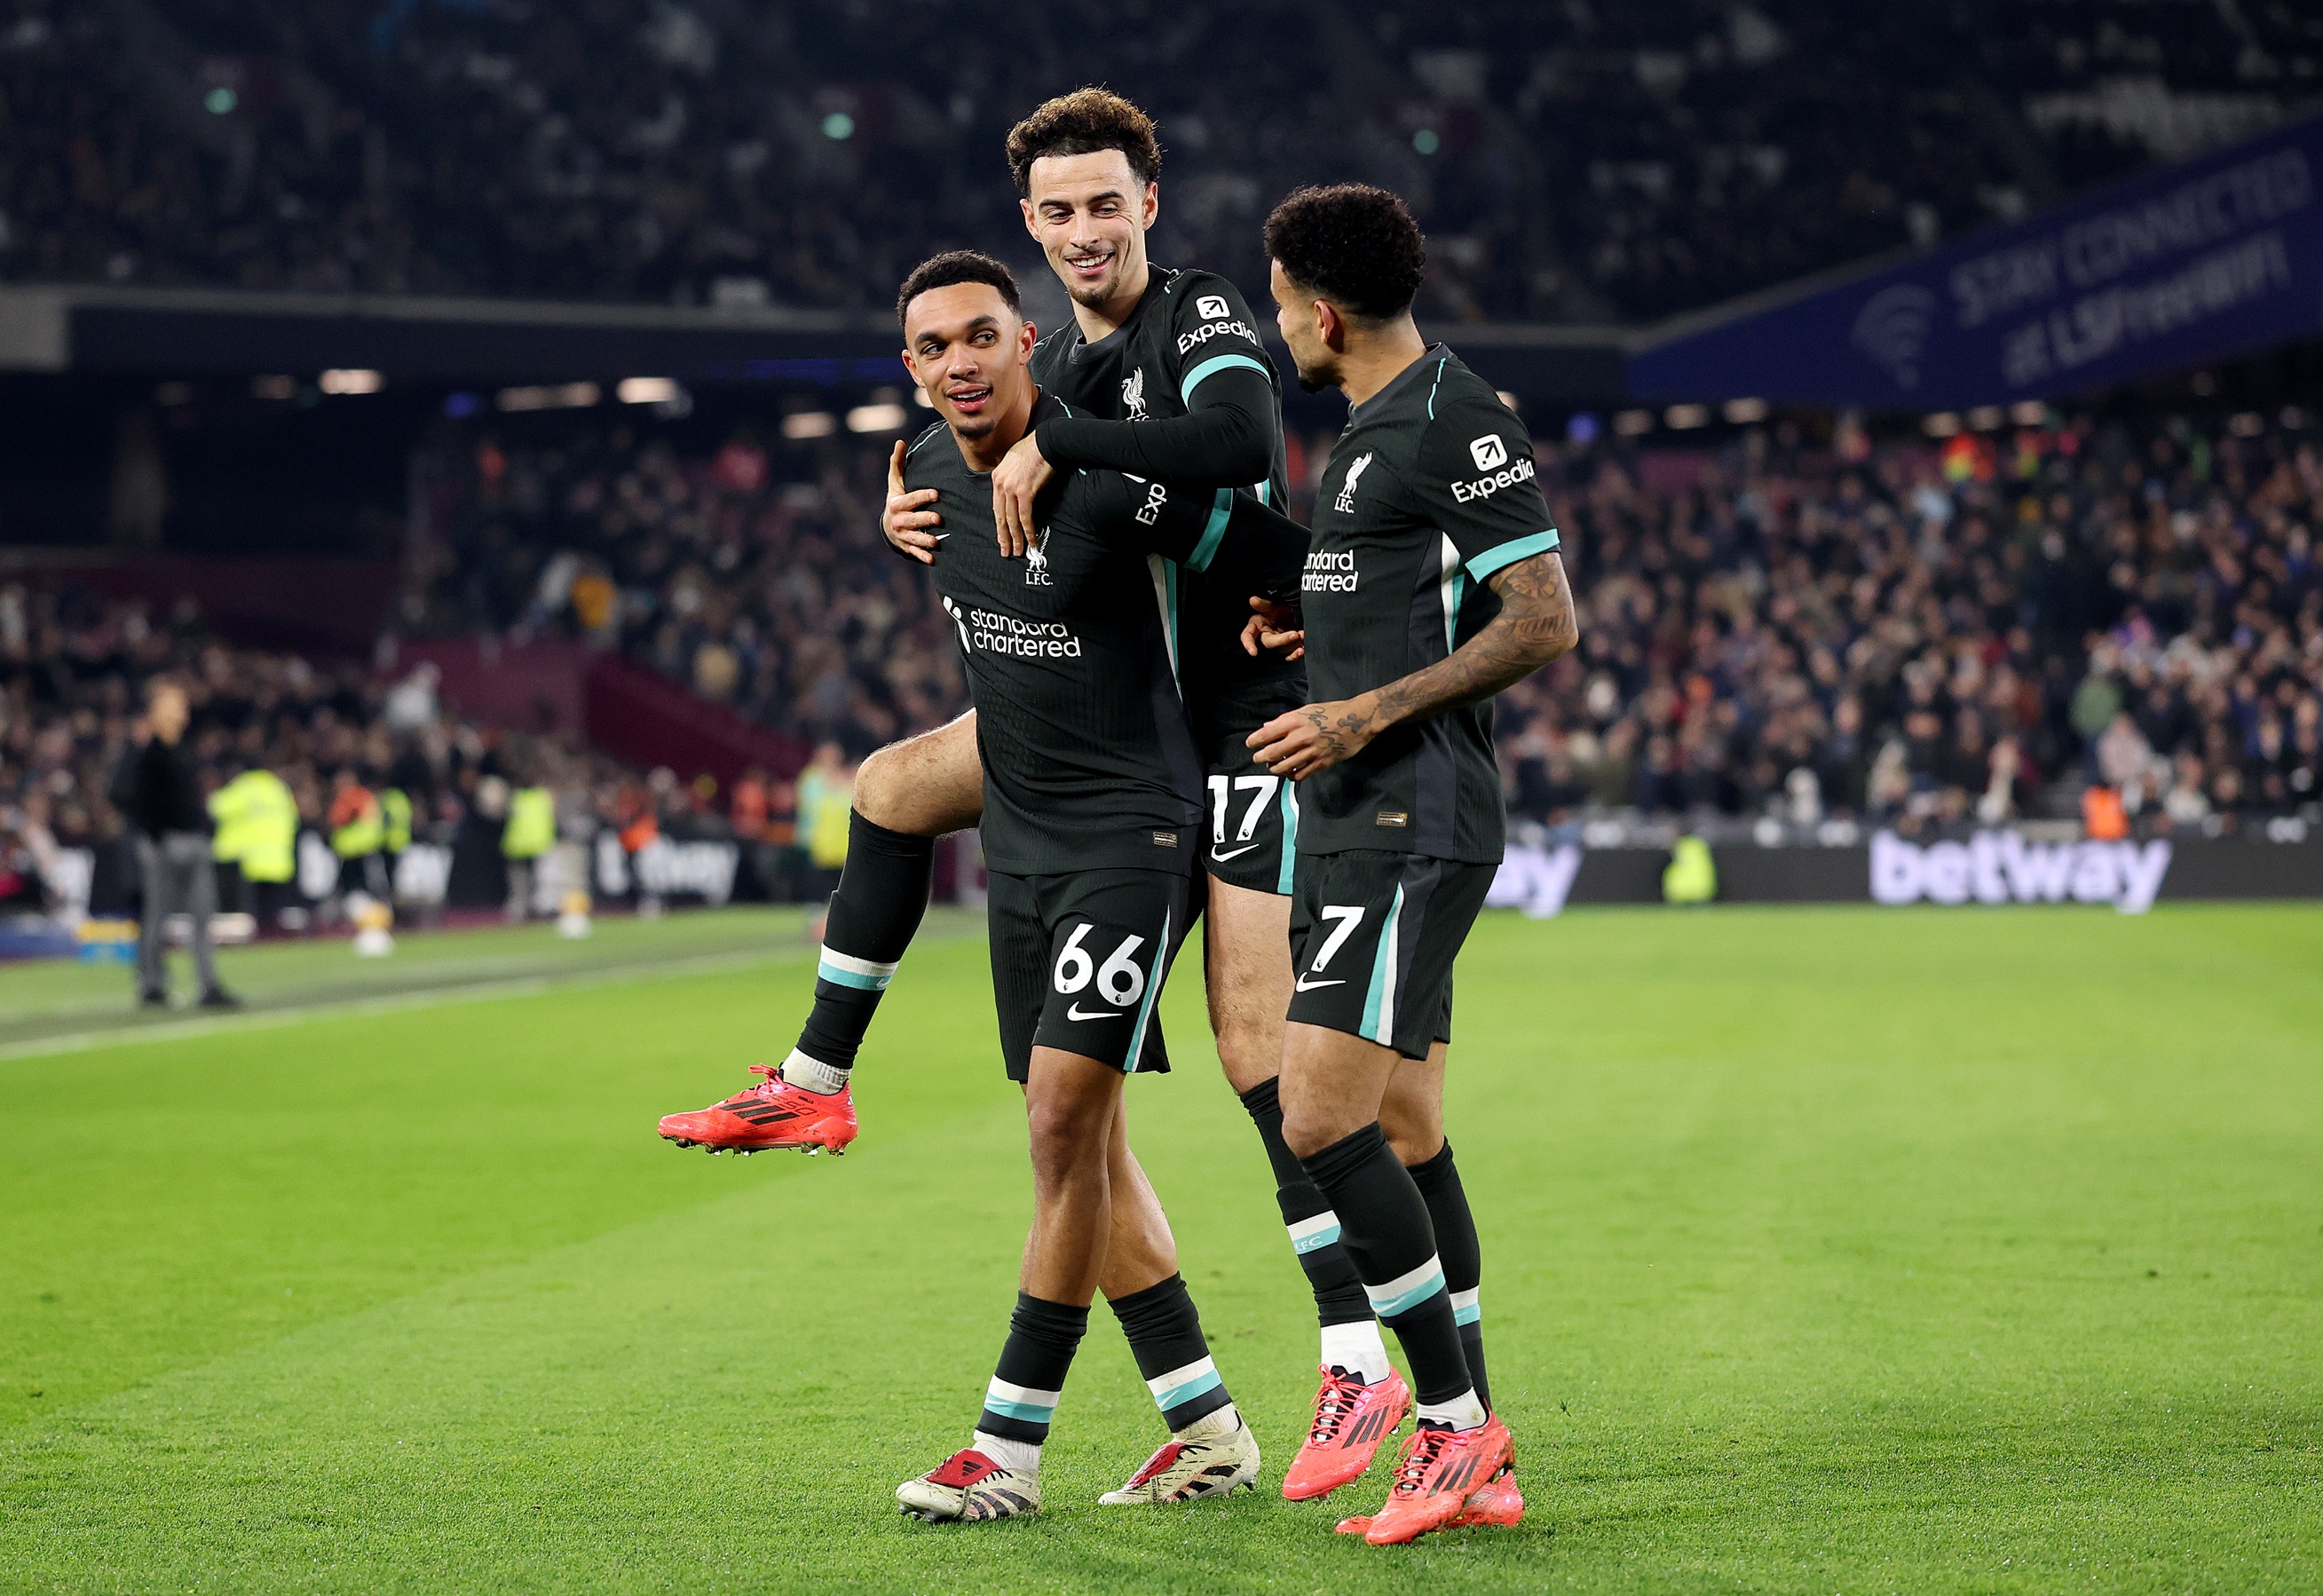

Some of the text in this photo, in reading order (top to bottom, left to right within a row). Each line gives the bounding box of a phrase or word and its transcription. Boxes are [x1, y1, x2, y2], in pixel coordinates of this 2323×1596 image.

[1177, 320, 1257, 355] Expedia
[1451, 459, 1534, 502] Expedia
[971, 609, 1069, 638] standard
[974, 628, 1081, 658] chartered
[1208, 775, 1279, 844] 17
[1869, 834, 2171, 913] betway
[1055, 923, 1145, 1007] 66
[1311, 905, 1366, 973] 7
